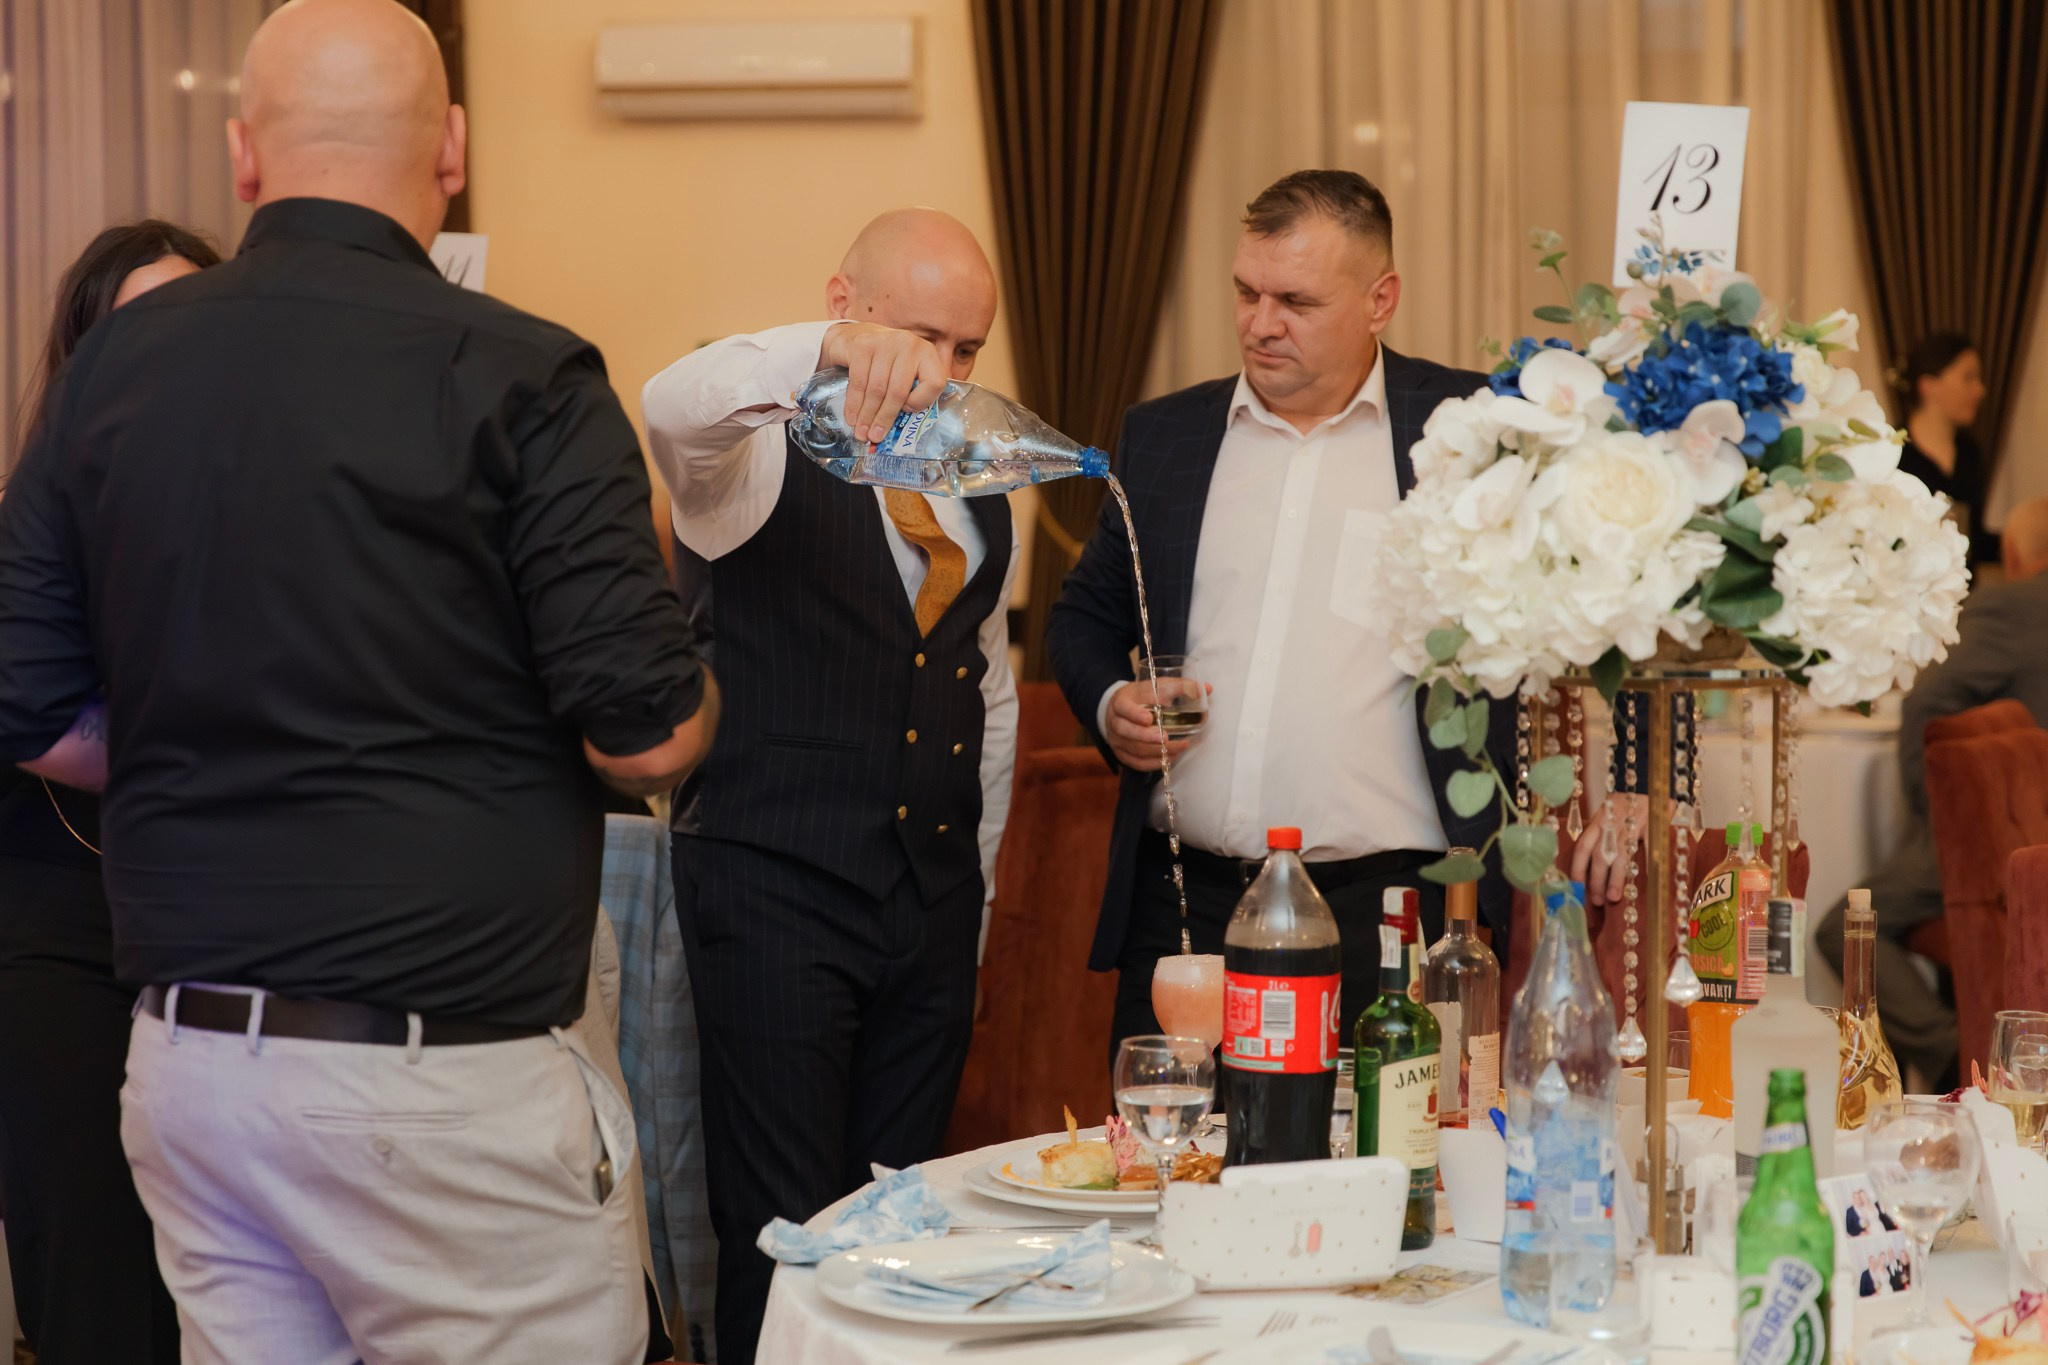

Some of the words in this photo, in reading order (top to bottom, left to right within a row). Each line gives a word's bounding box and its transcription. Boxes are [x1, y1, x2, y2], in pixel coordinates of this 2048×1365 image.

[1643, 142, 1719, 214] 13
[903, 406, 929, 447] OVINA
[1693, 878, 1726, 909] ARK
[1701, 913, 1728, 938] COOL
[1701, 983, 1732, 1002] VANȚI
[1395, 1063, 1440, 1089] JAME
